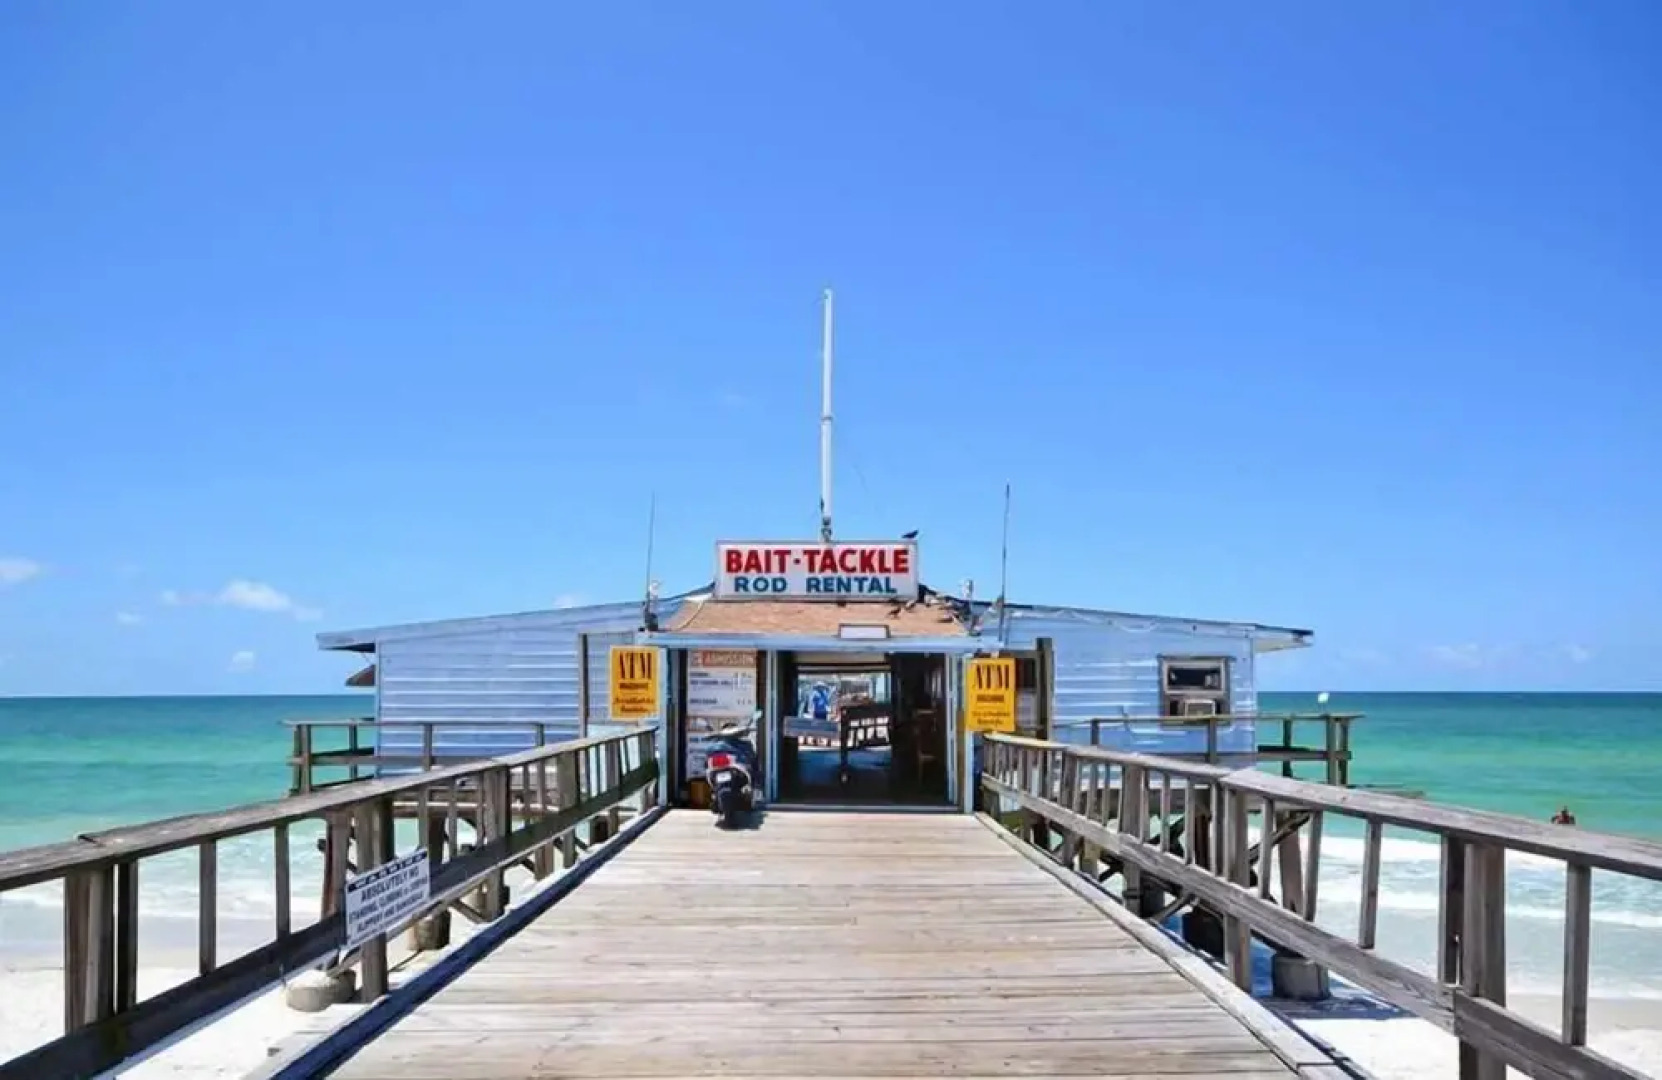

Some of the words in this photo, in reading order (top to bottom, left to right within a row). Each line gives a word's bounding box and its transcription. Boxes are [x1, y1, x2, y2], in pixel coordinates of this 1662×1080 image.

[734, 577, 788, 593] ROD
[806, 576, 897, 593] RENTAL
[618, 651, 653, 679] ATM
[975, 663, 1010, 690] ATM
[361, 871, 408, 903] ABSOLUTELY
